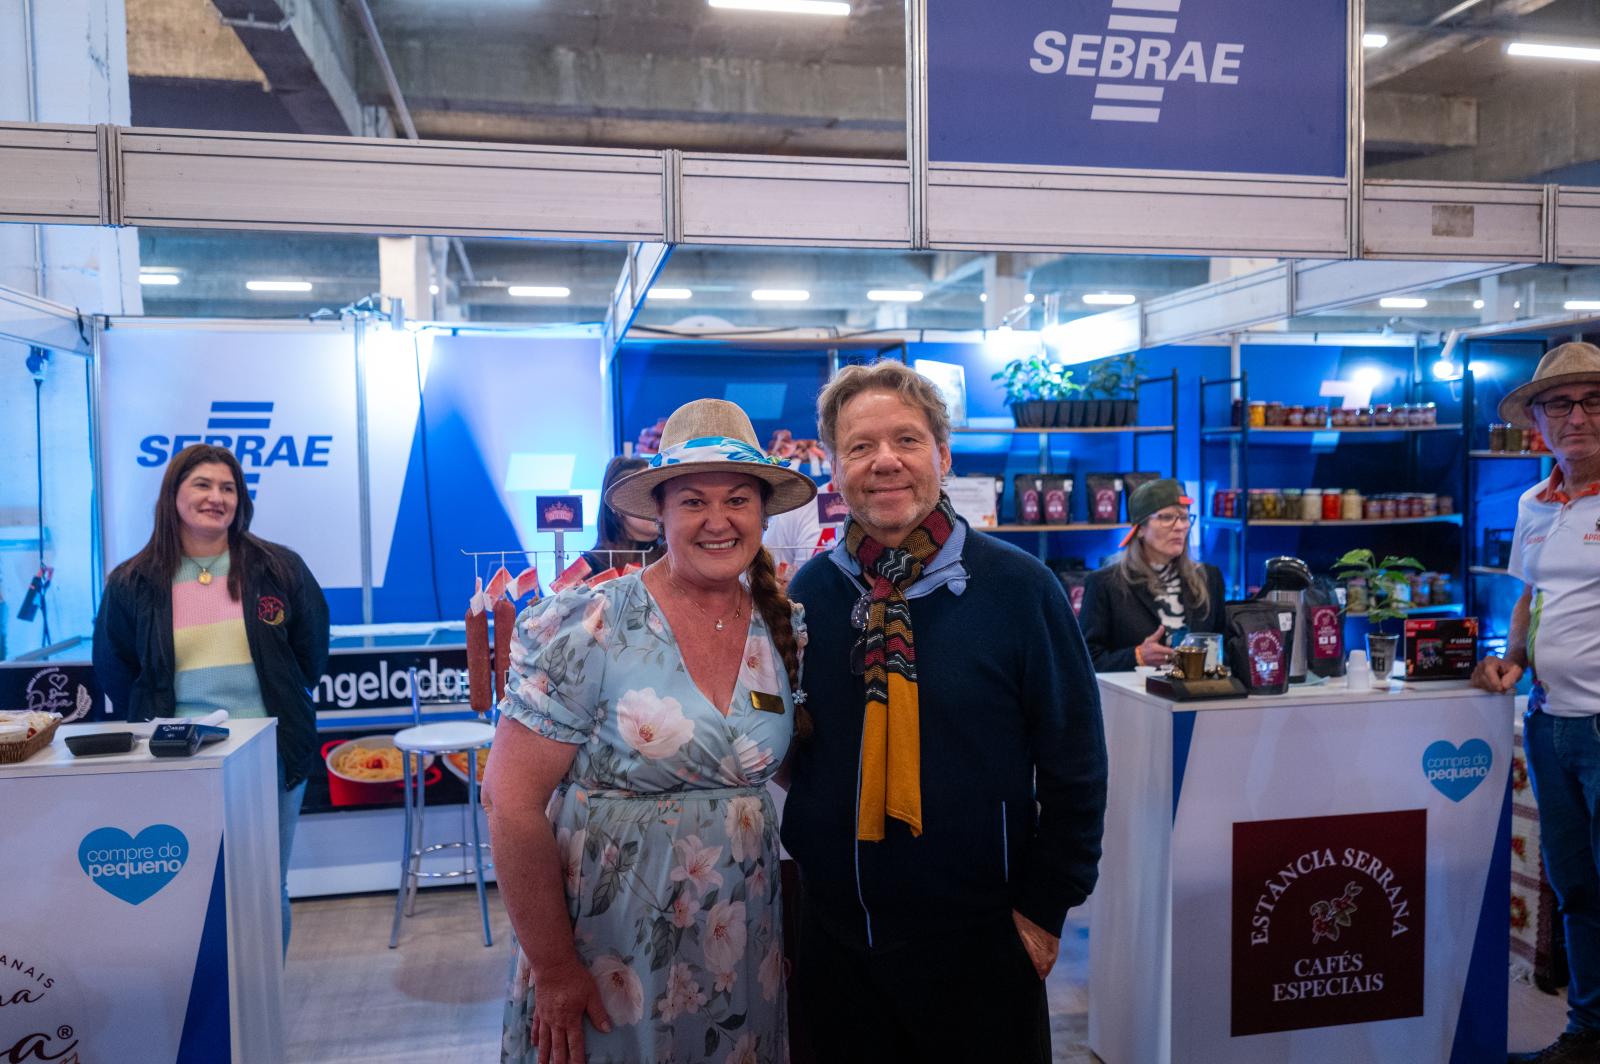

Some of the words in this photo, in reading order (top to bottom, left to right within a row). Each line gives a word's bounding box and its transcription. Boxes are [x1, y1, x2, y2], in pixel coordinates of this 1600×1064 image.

[1029, 30, 1245, 84] SEBRAE
[1427, 756, 1471, 769] compre
[1472, 753, 1488, 766] do
[1428, 766, 1487, 782] pequeno
[87, 847, 154, 867] compre
[158, 842, 181, 858] do
[88, 859, 182, 880] pequeno
[1251, 848, 1337, 946] ESTÂNCIA
[1341, 848, 1410, 938] SERRANA
[1294, 951, 1364, 977] CAFÉS
[1272, 973, 1384, 1002] ESPECIAIS
